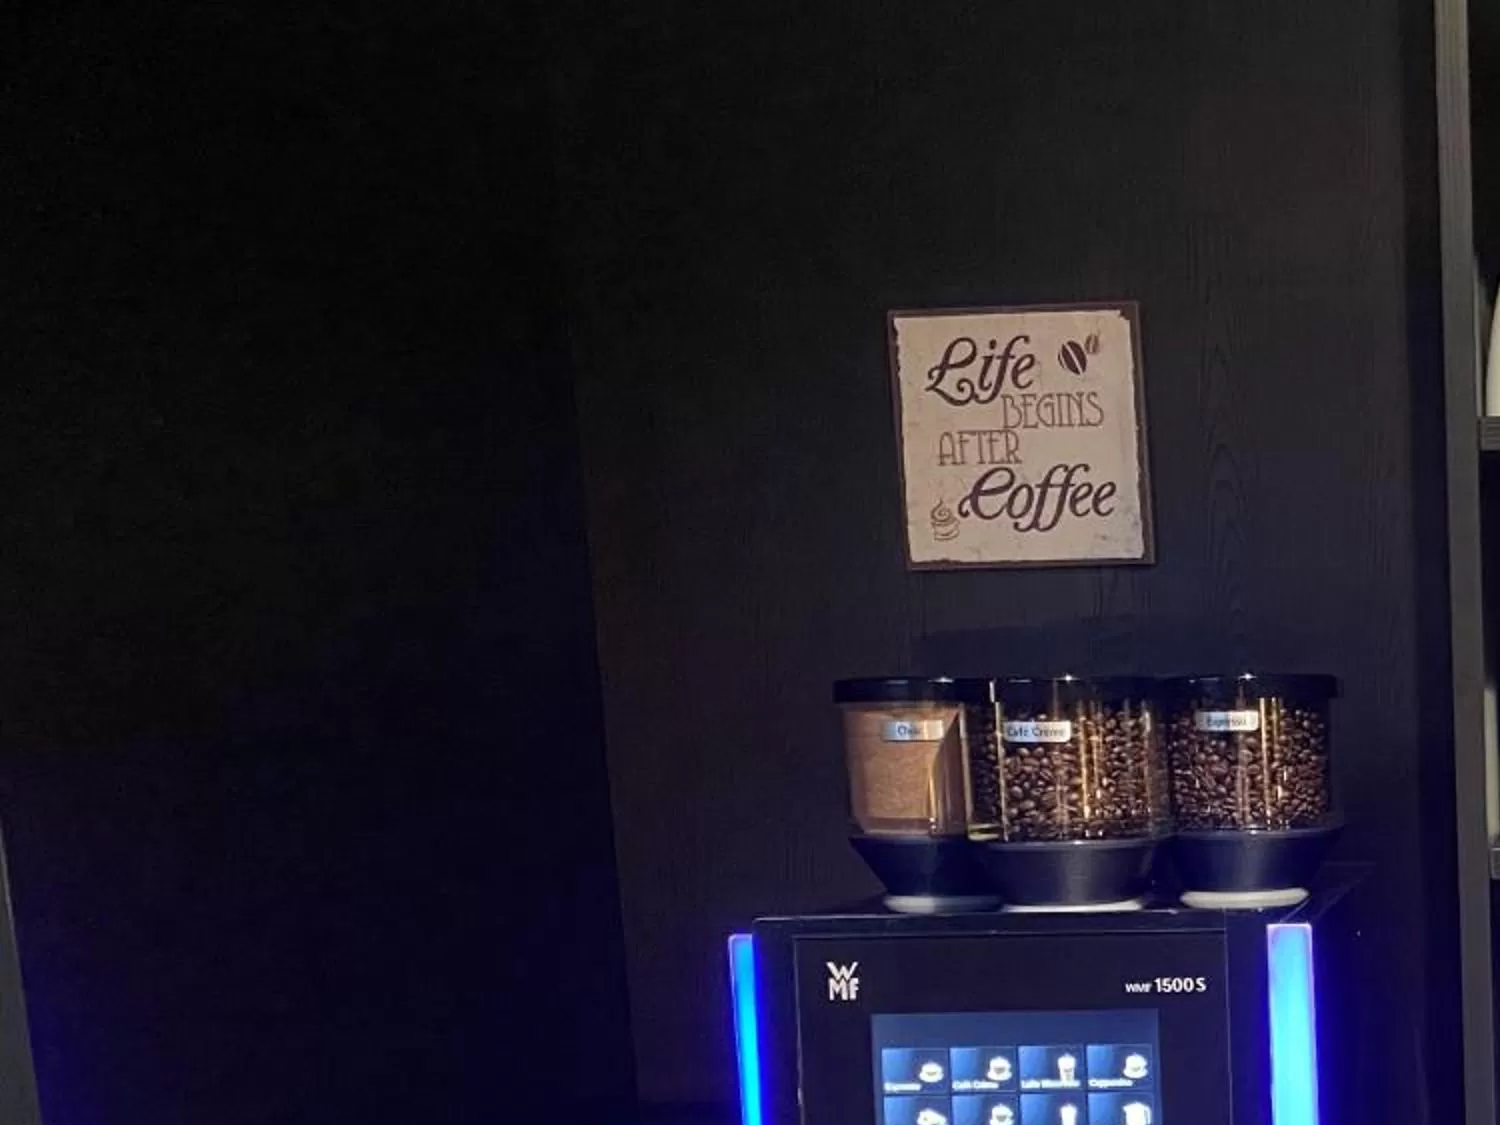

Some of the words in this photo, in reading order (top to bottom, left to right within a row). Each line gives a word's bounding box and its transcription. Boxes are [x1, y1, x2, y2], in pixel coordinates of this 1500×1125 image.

[925, 335, 1036, 406] Life
[1001, 391, 1105, 429] BEGINS
[938, 430, 1023, 467] AFTER
[957, 463, 1117, 532] Coffee
[1154, 977, 1194, 993] 1500
